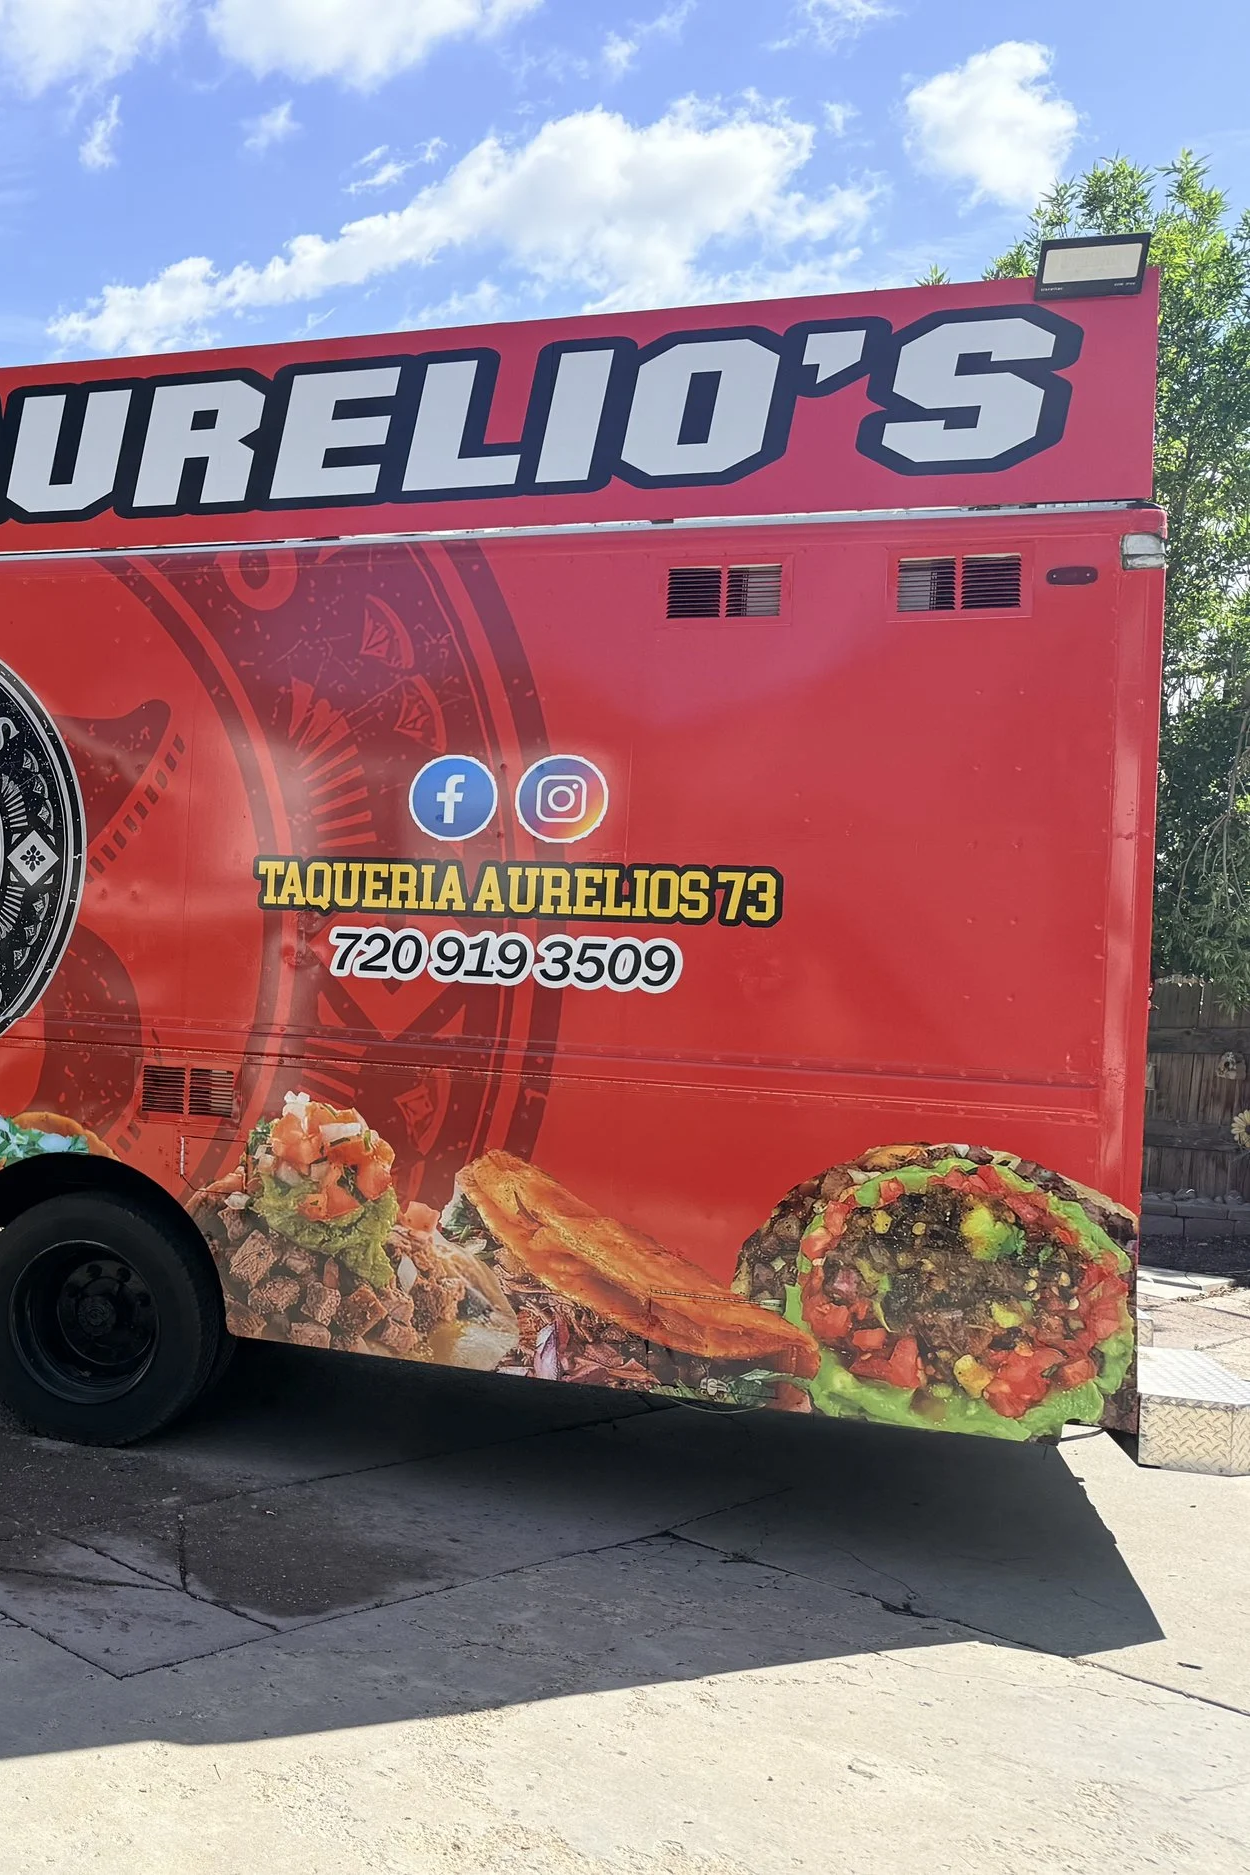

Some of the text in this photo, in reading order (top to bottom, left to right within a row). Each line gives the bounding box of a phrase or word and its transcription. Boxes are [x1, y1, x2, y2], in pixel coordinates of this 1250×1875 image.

[256, 860, 777, 921] TAQUERIA AURELIOS 73
[332, 932, 678, 986] 720 919 3509
